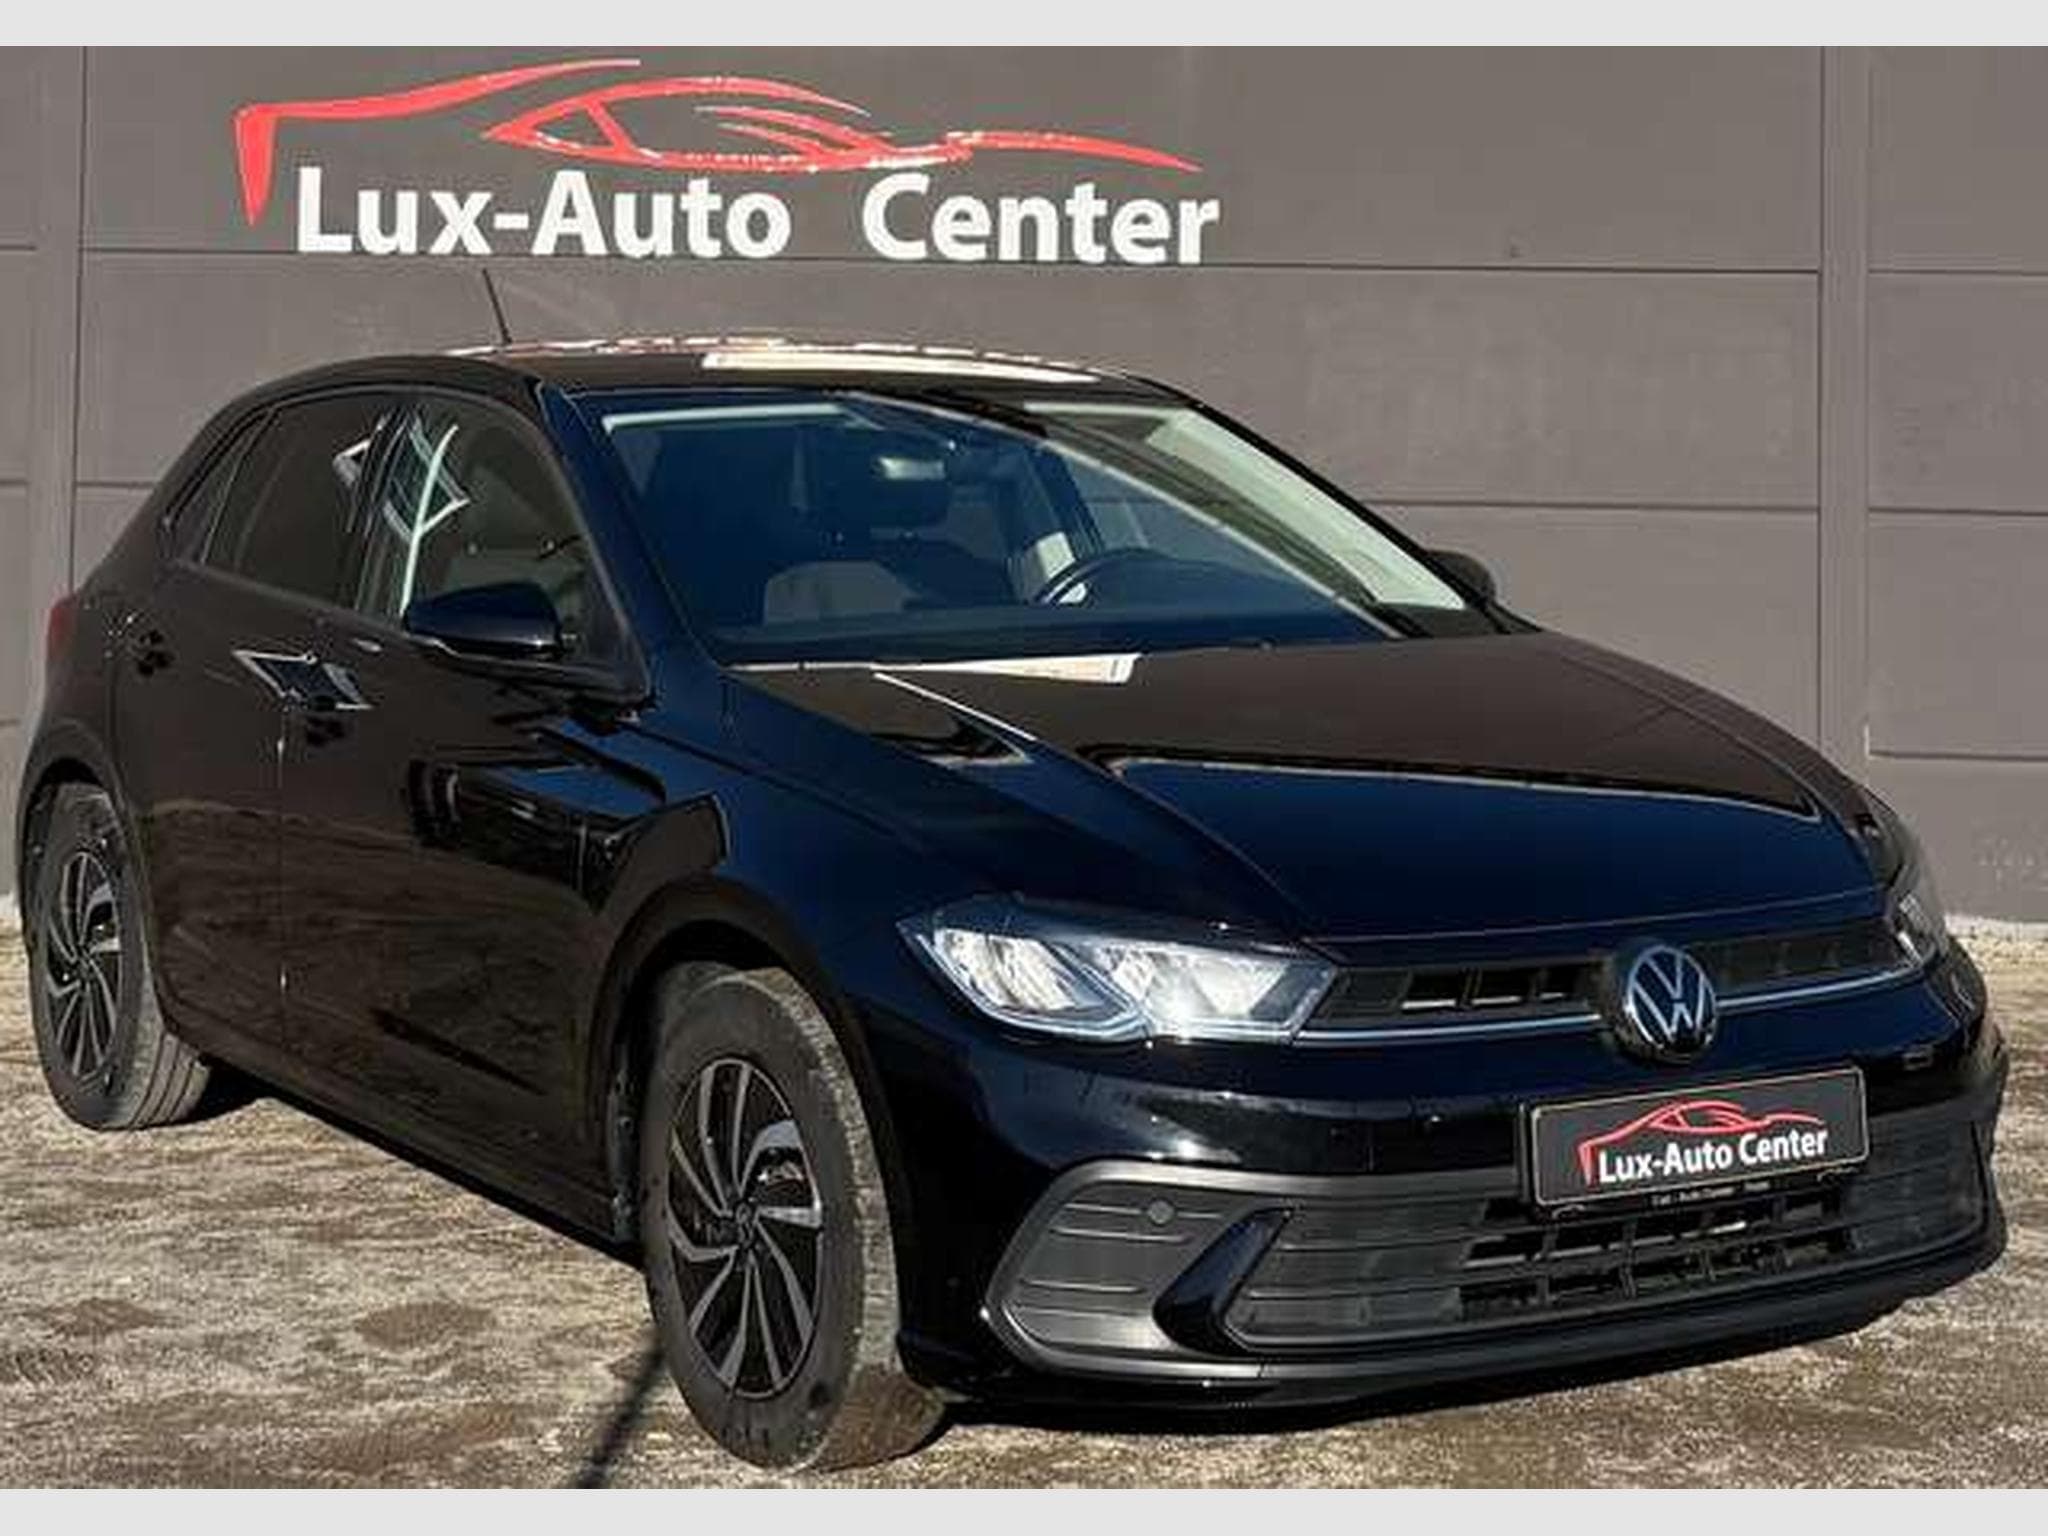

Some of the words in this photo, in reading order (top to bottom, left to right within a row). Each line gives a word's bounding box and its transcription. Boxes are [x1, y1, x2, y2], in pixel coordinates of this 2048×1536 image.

[297, 166, 792, 258] Lux-Auto
[862, 172, 1220, 264] Center
[1599, 1139, 1734, 1183] Lux-Auto
[1738, 1128, 1829, 1166] Center
